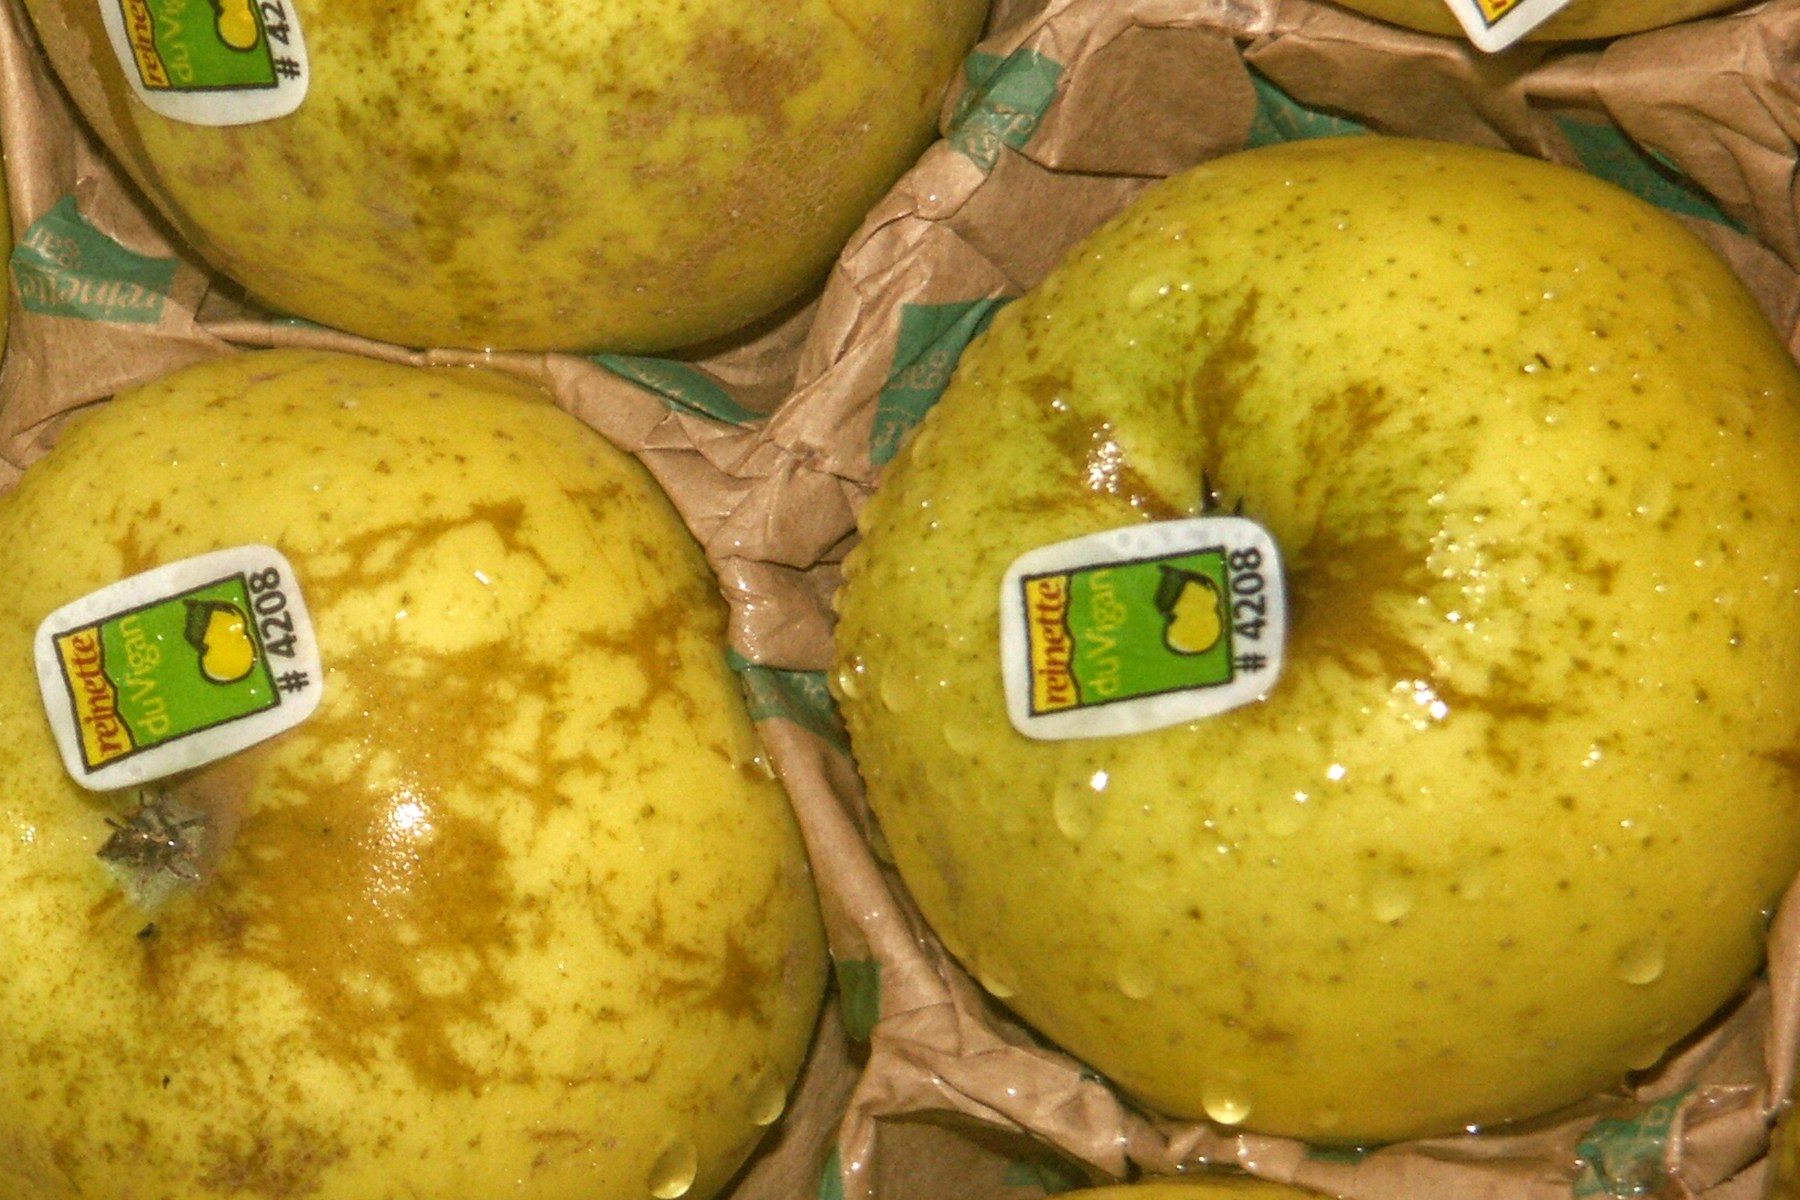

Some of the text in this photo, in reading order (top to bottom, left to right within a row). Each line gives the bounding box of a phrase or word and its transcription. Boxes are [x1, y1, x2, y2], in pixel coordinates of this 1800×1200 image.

[274, 56, 301, 80] #
[250, 566, 310, 694] # 4208
[1036, 580, 1069, 705] reinette
[1228, 546, 1267, 674] # 4208
[71, 633, 124, 758] reinette
